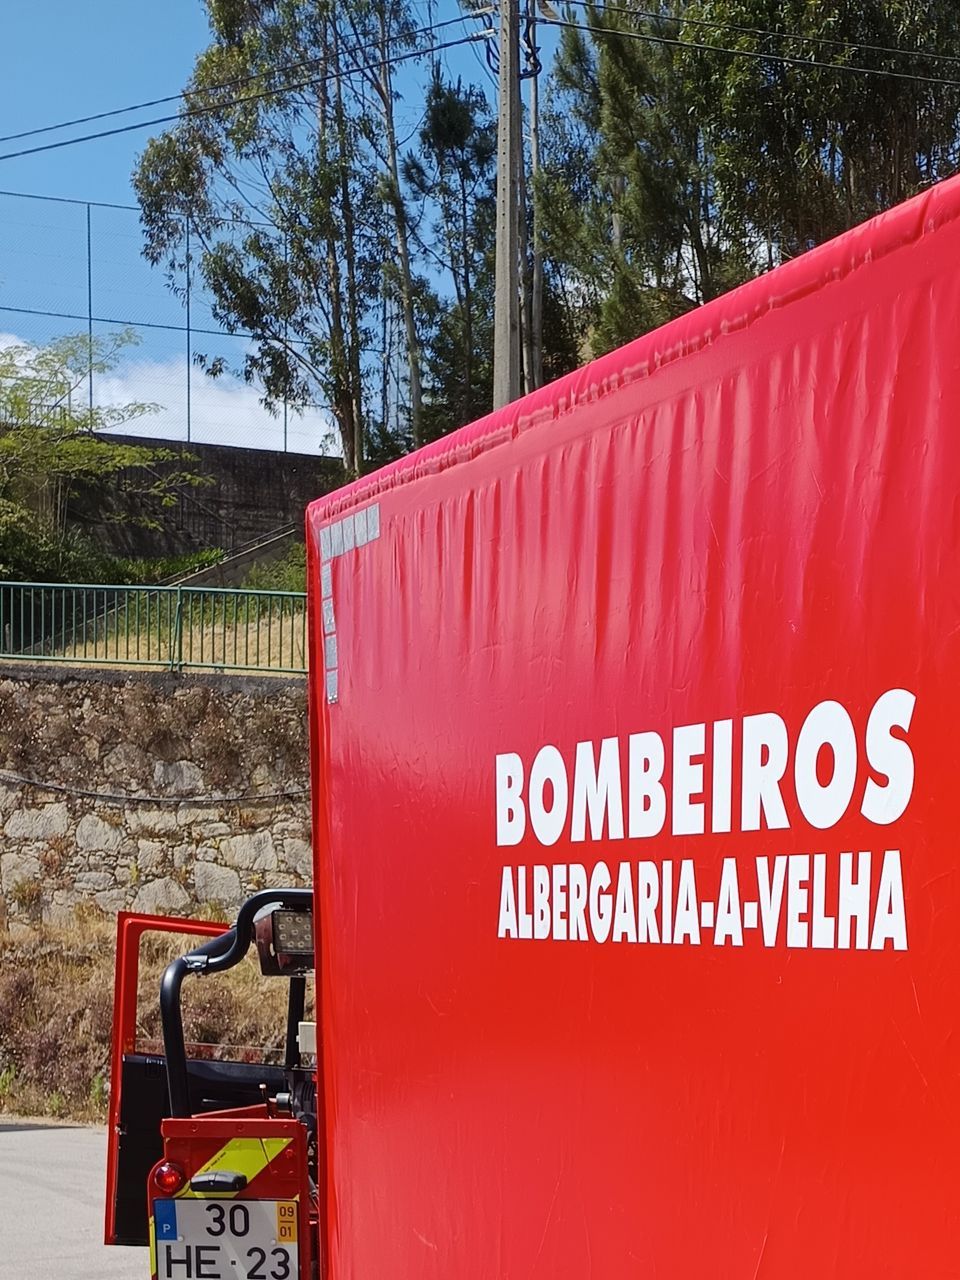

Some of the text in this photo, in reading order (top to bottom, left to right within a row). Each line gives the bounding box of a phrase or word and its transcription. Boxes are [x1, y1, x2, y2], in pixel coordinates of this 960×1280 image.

[496, 688, 917, 847] BOMBEIROS
[498, 849, 908, 951] ALBERGARIA-A-VELHA
[205, 1204, 250, 1237] 30
[279, 1206, 295, 1217] 09
[163, 1224, 171, 1233] P
[279, 1226, 292, 1237] 01
